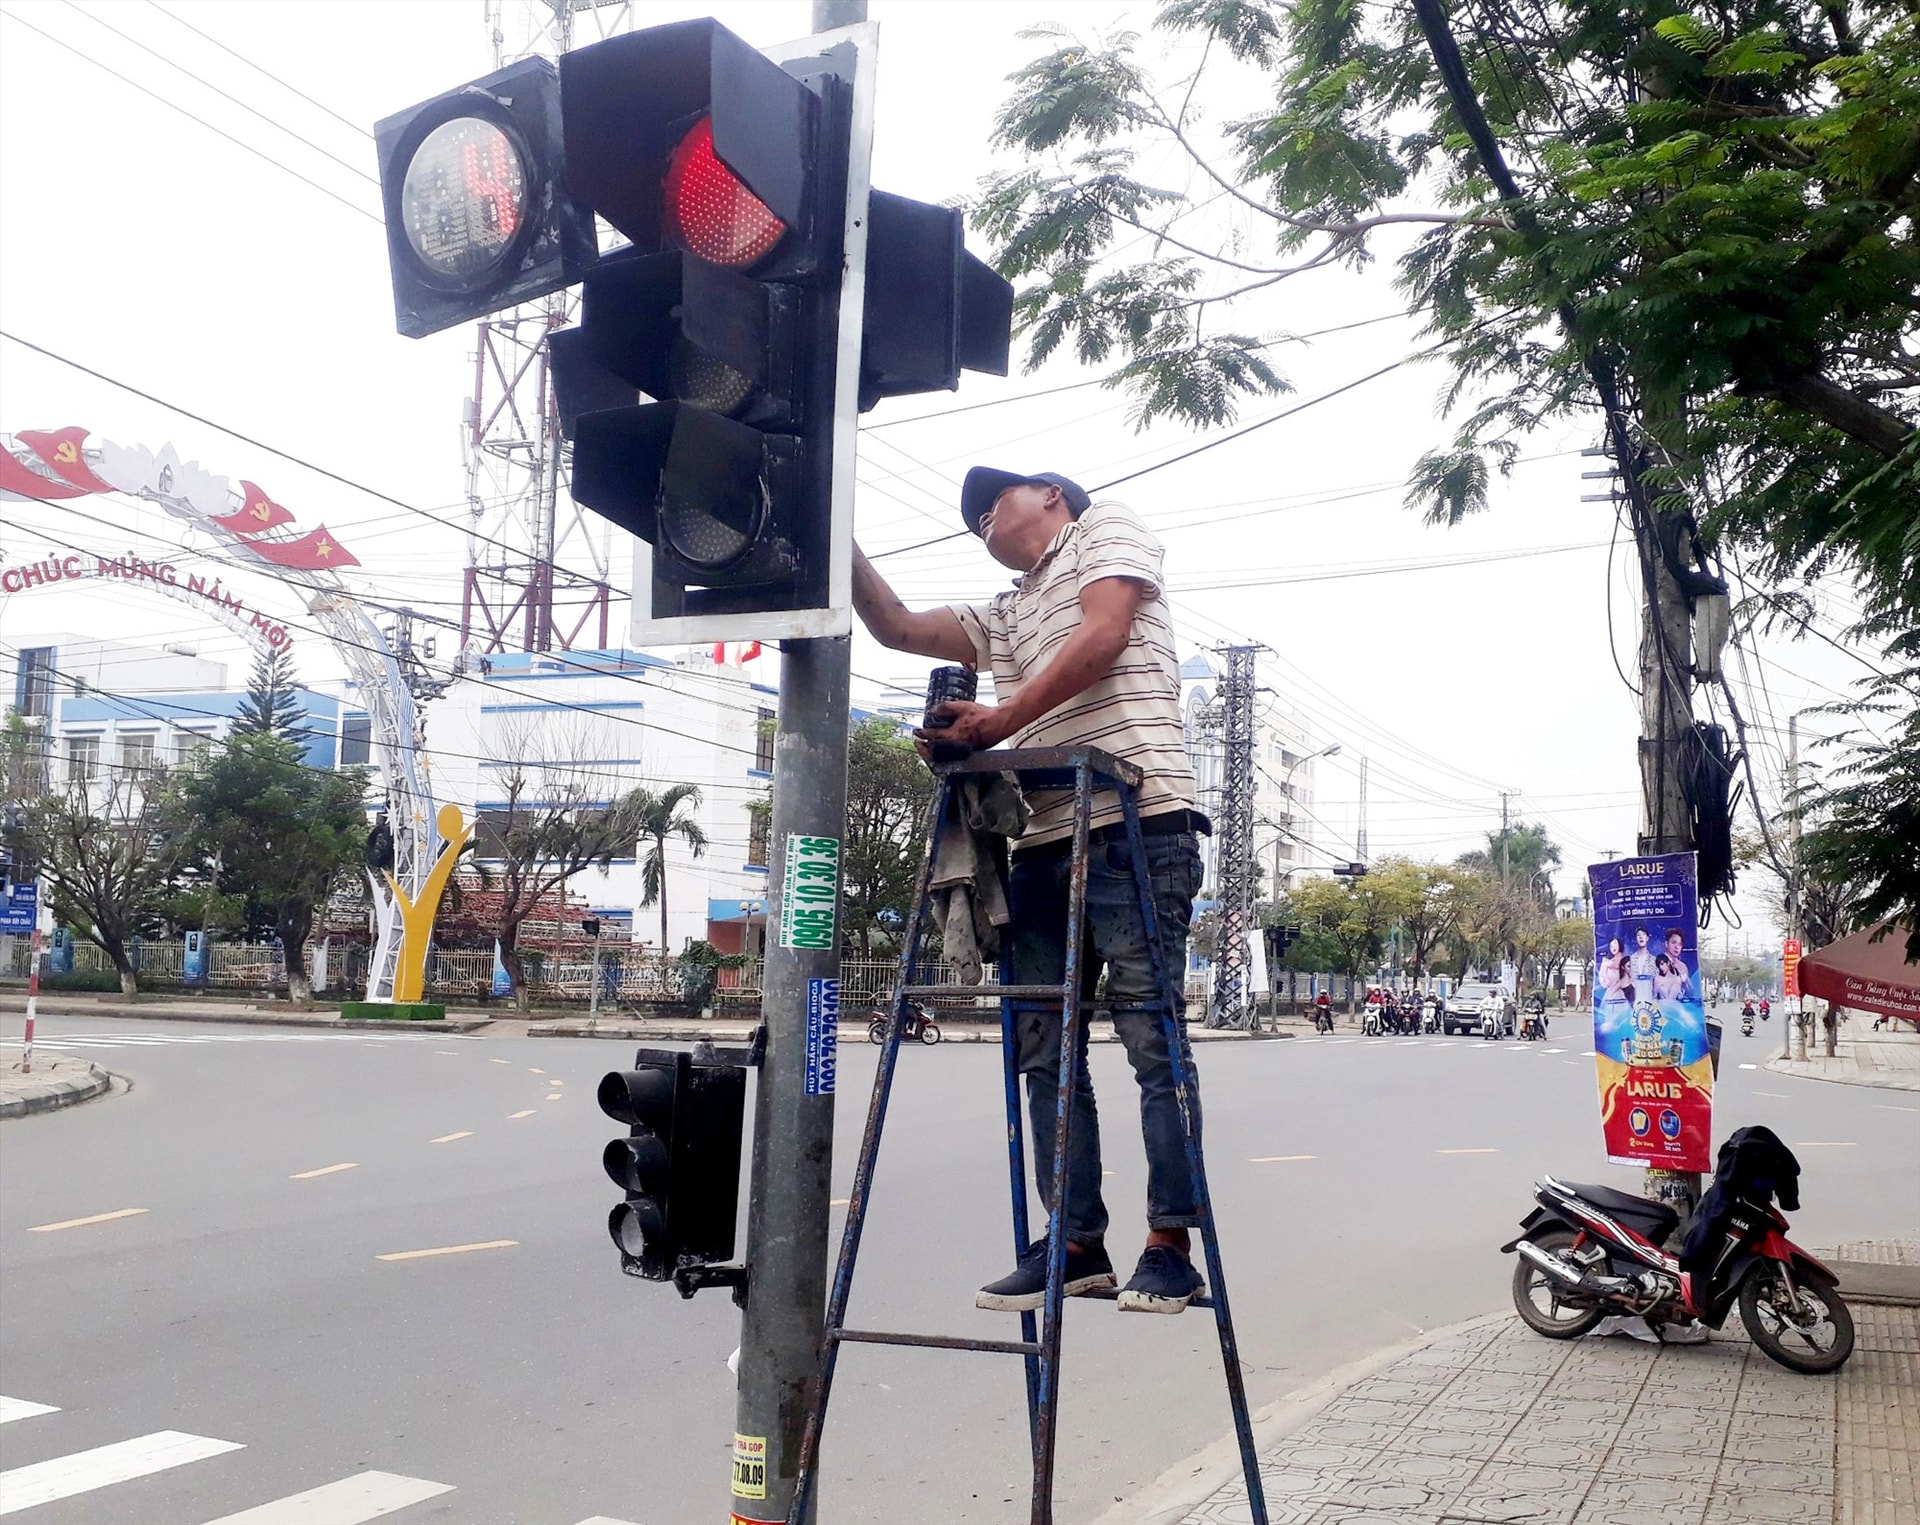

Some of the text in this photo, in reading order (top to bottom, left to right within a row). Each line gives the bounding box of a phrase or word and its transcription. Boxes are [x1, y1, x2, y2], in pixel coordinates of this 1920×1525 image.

[1619, 862, 1665, 877] LARUE
[792, 838, 838, 948] 0905.10.30.36
[1626, 1080, 1682, 1098] LARUE
